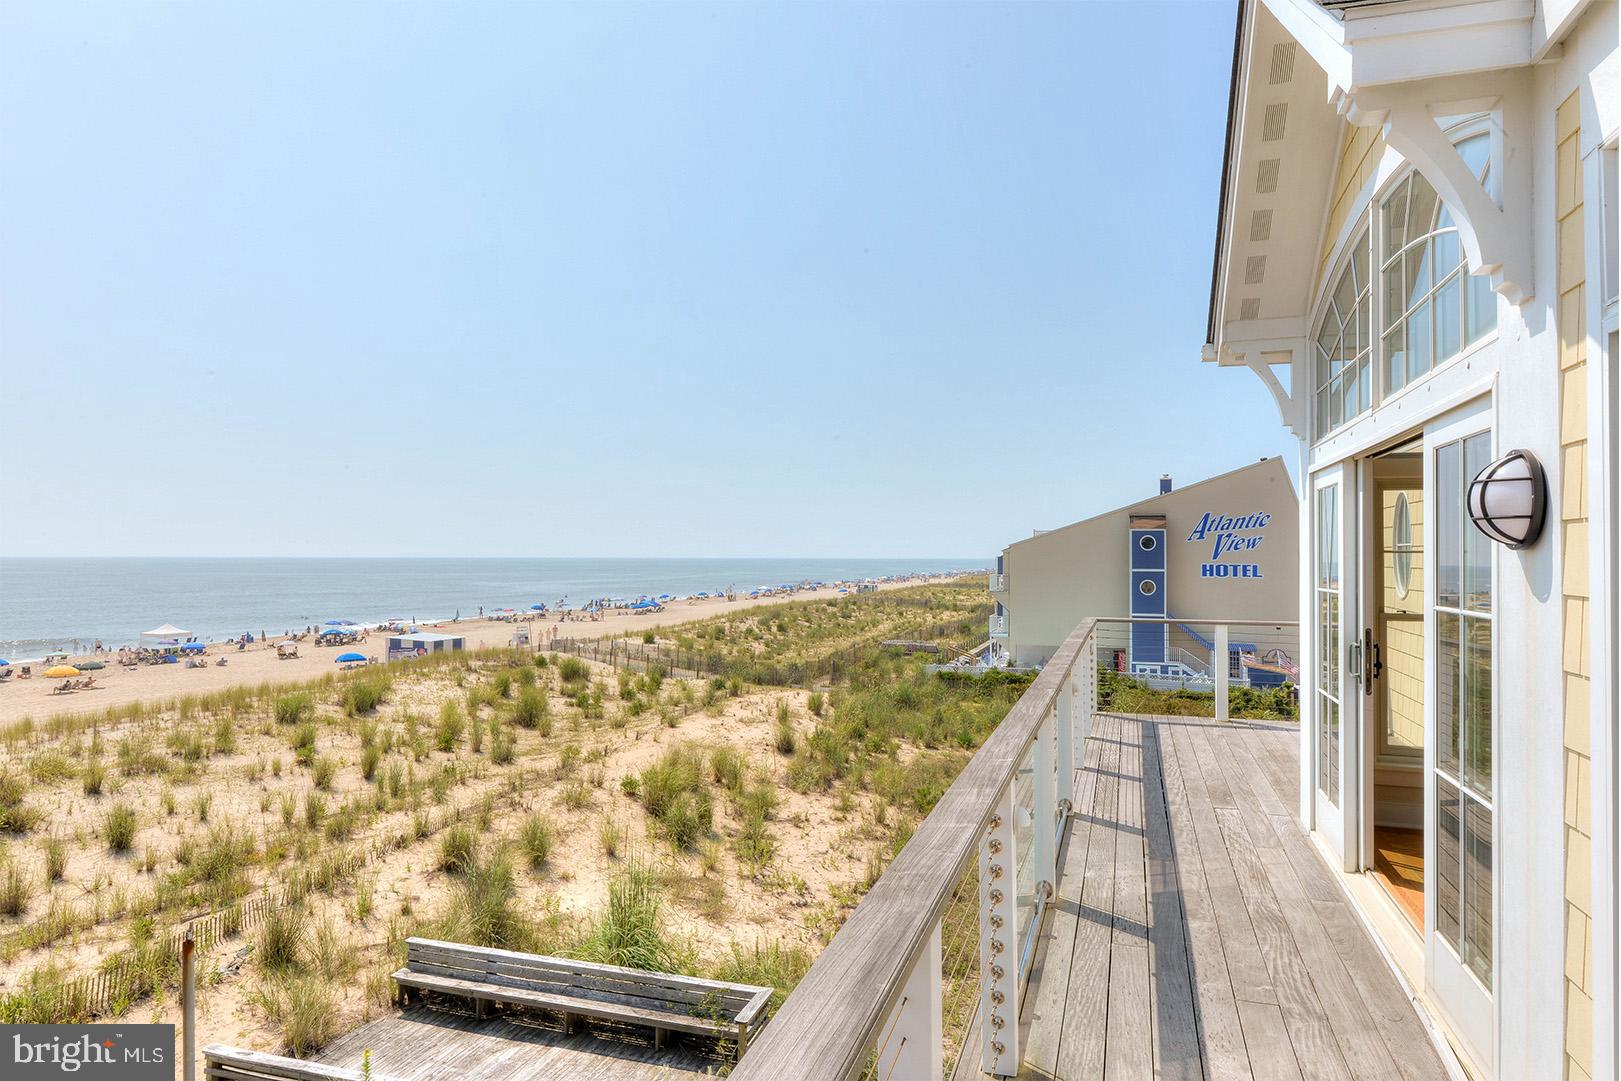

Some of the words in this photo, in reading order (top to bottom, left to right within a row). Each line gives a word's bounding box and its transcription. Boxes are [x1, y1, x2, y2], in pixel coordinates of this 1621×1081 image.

[1186, 511, 1271, 542] Atlantic
[1212, 532, 1263, 560] View
[1201, 563, 1263, 578] HOTEL
